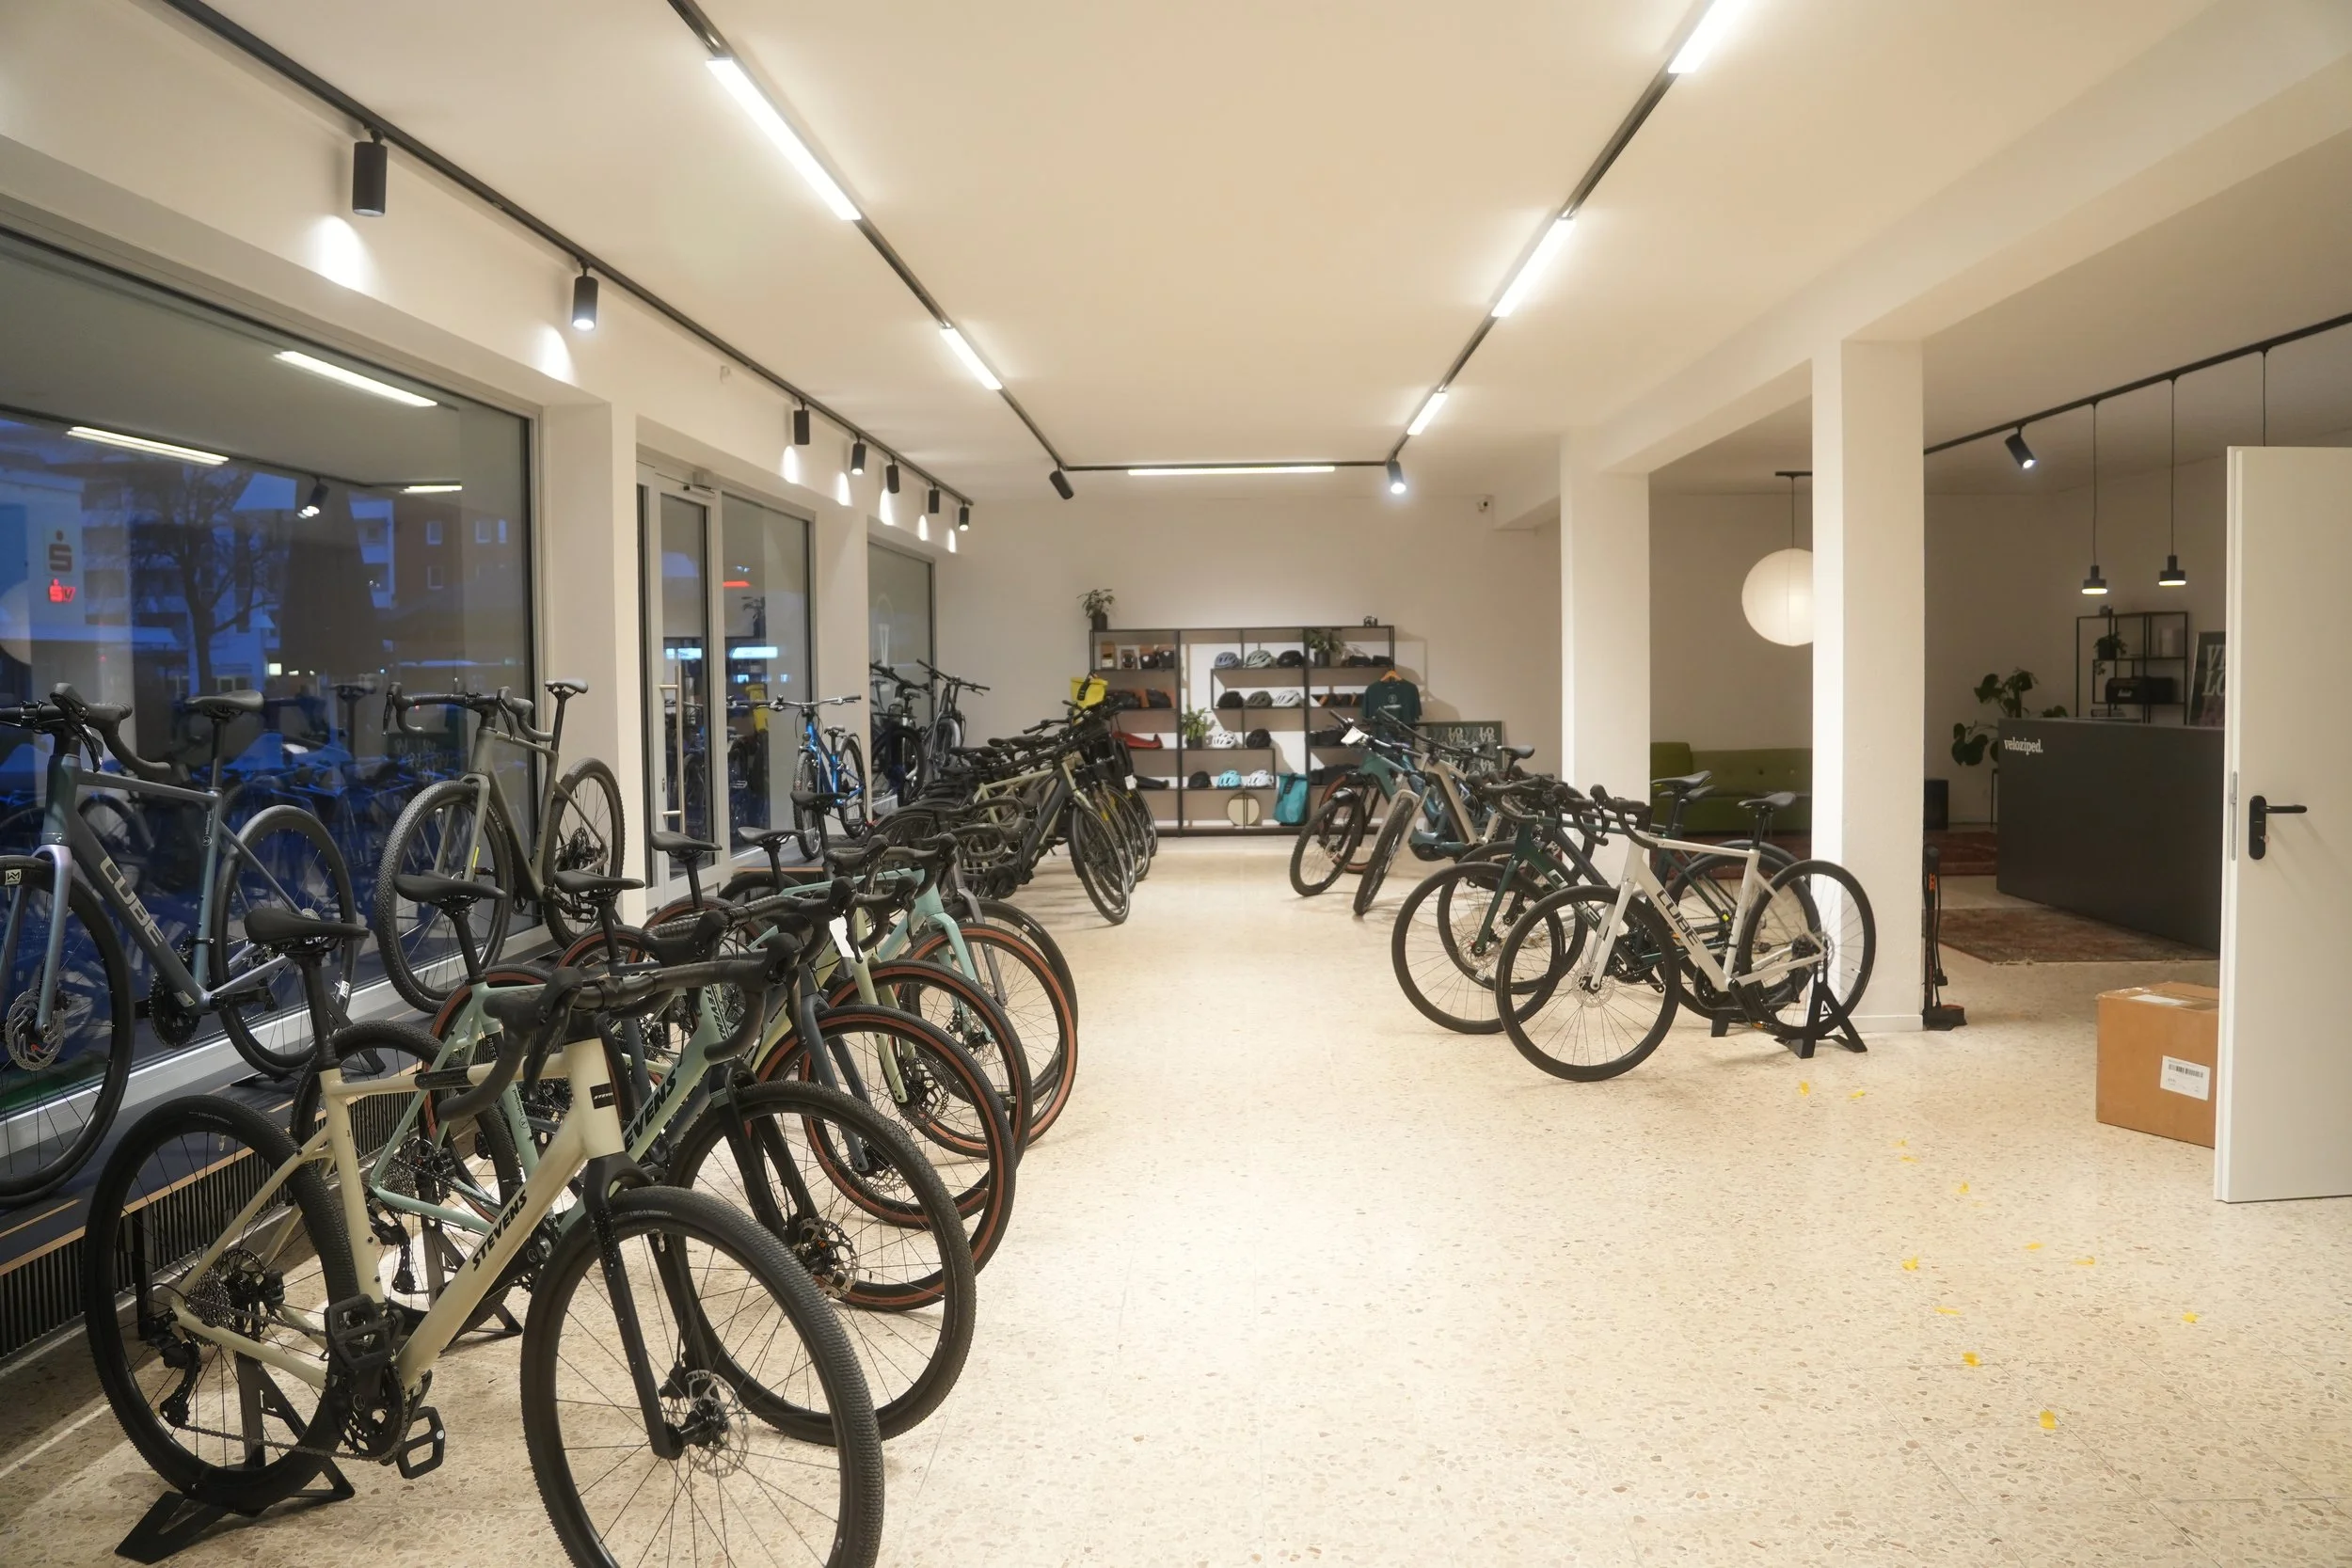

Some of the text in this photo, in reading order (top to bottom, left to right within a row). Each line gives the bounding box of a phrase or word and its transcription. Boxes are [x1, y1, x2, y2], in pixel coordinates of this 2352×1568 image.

[100, 855, 166, 948] CUBE
[1548, 868, 1600, 924] CBE
[1656, 889, 1701, 946] CUBE
[706, 986, 730, 1040] TEVENS
[487, 1037, 499, 1060] PREST
[624, 1069, 677, 1153] EVENS
[472, 1189, 528, 1273] STEVENS
